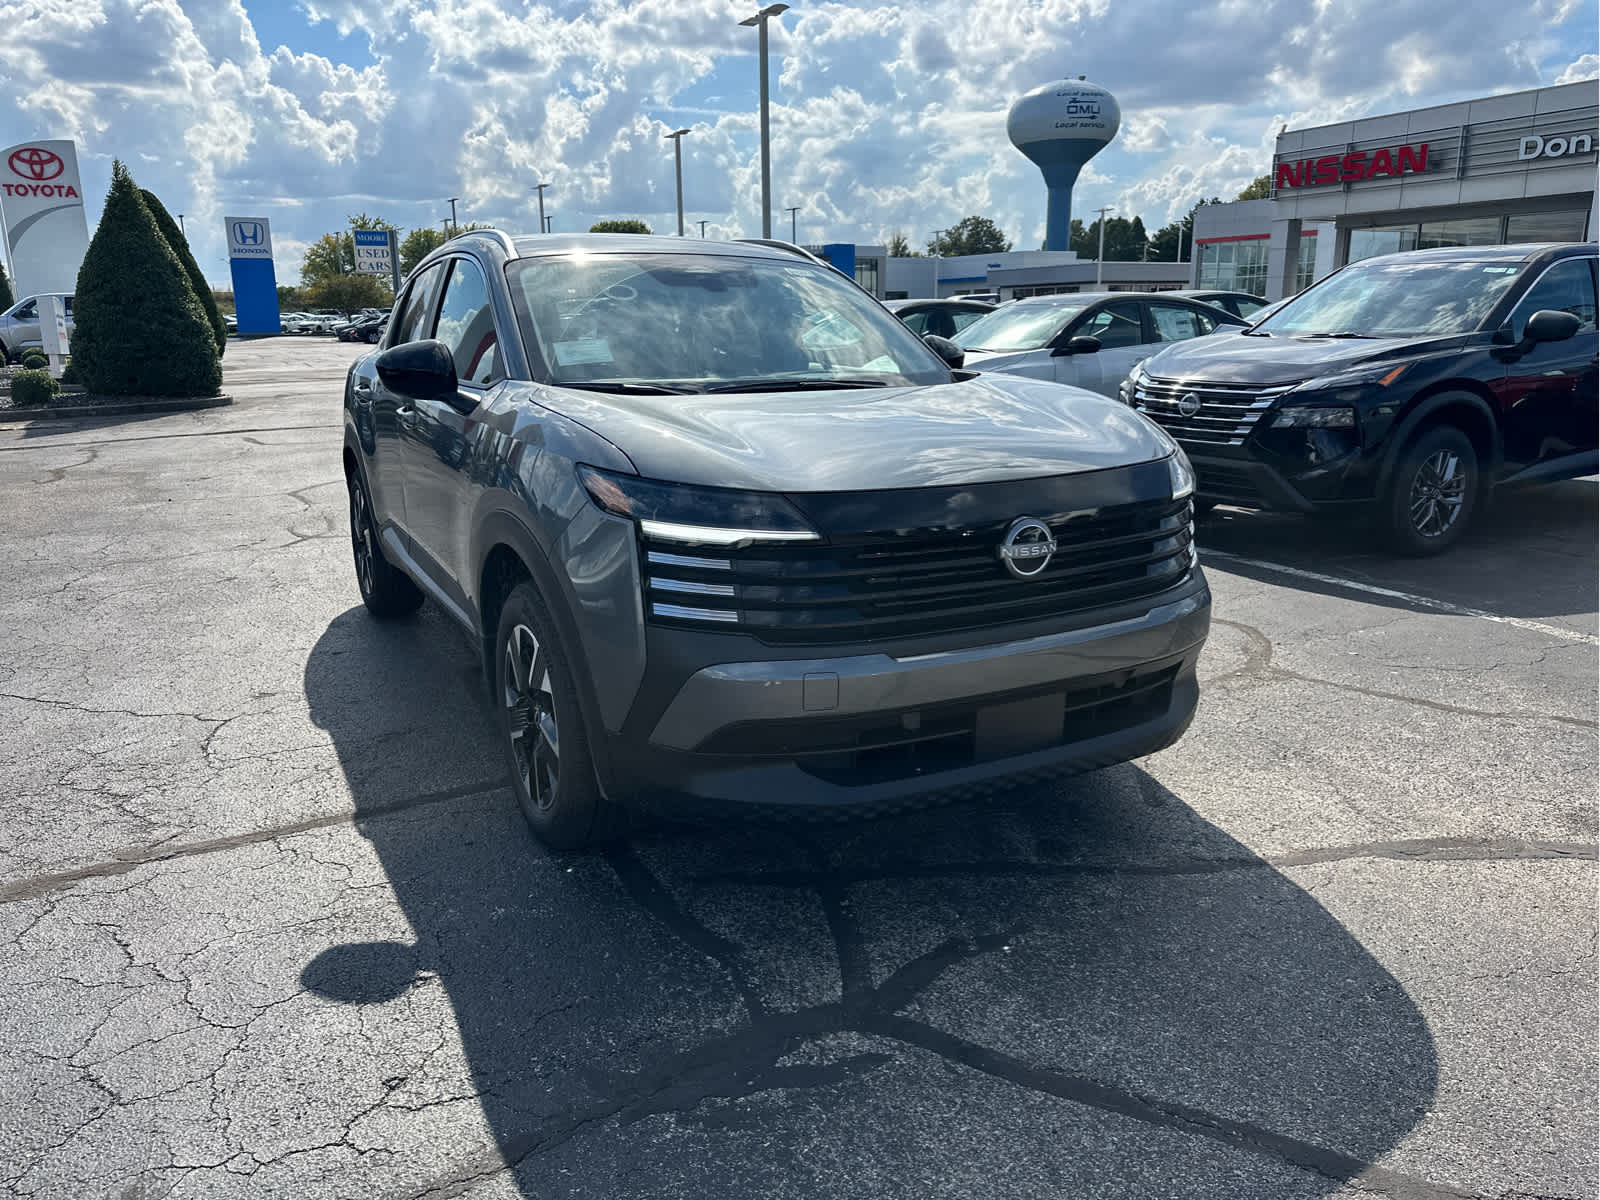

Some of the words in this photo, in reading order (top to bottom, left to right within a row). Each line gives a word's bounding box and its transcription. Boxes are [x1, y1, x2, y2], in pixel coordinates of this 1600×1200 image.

[1066, 105, 1101, 114] OMU
[1055, 120, 1079, 129] Local
[1518, 134, 1592, 160] Don
[1276, 143, 1429, 189] NISSAN
[2, 183, 79, 198] TOYOTA
[356, 233, 386, 241] MOORE
[357, 247, 390, 258] USED
[358, 261, 391, 271] CARS
[1001, 541, 1057, 557] NISSAN
